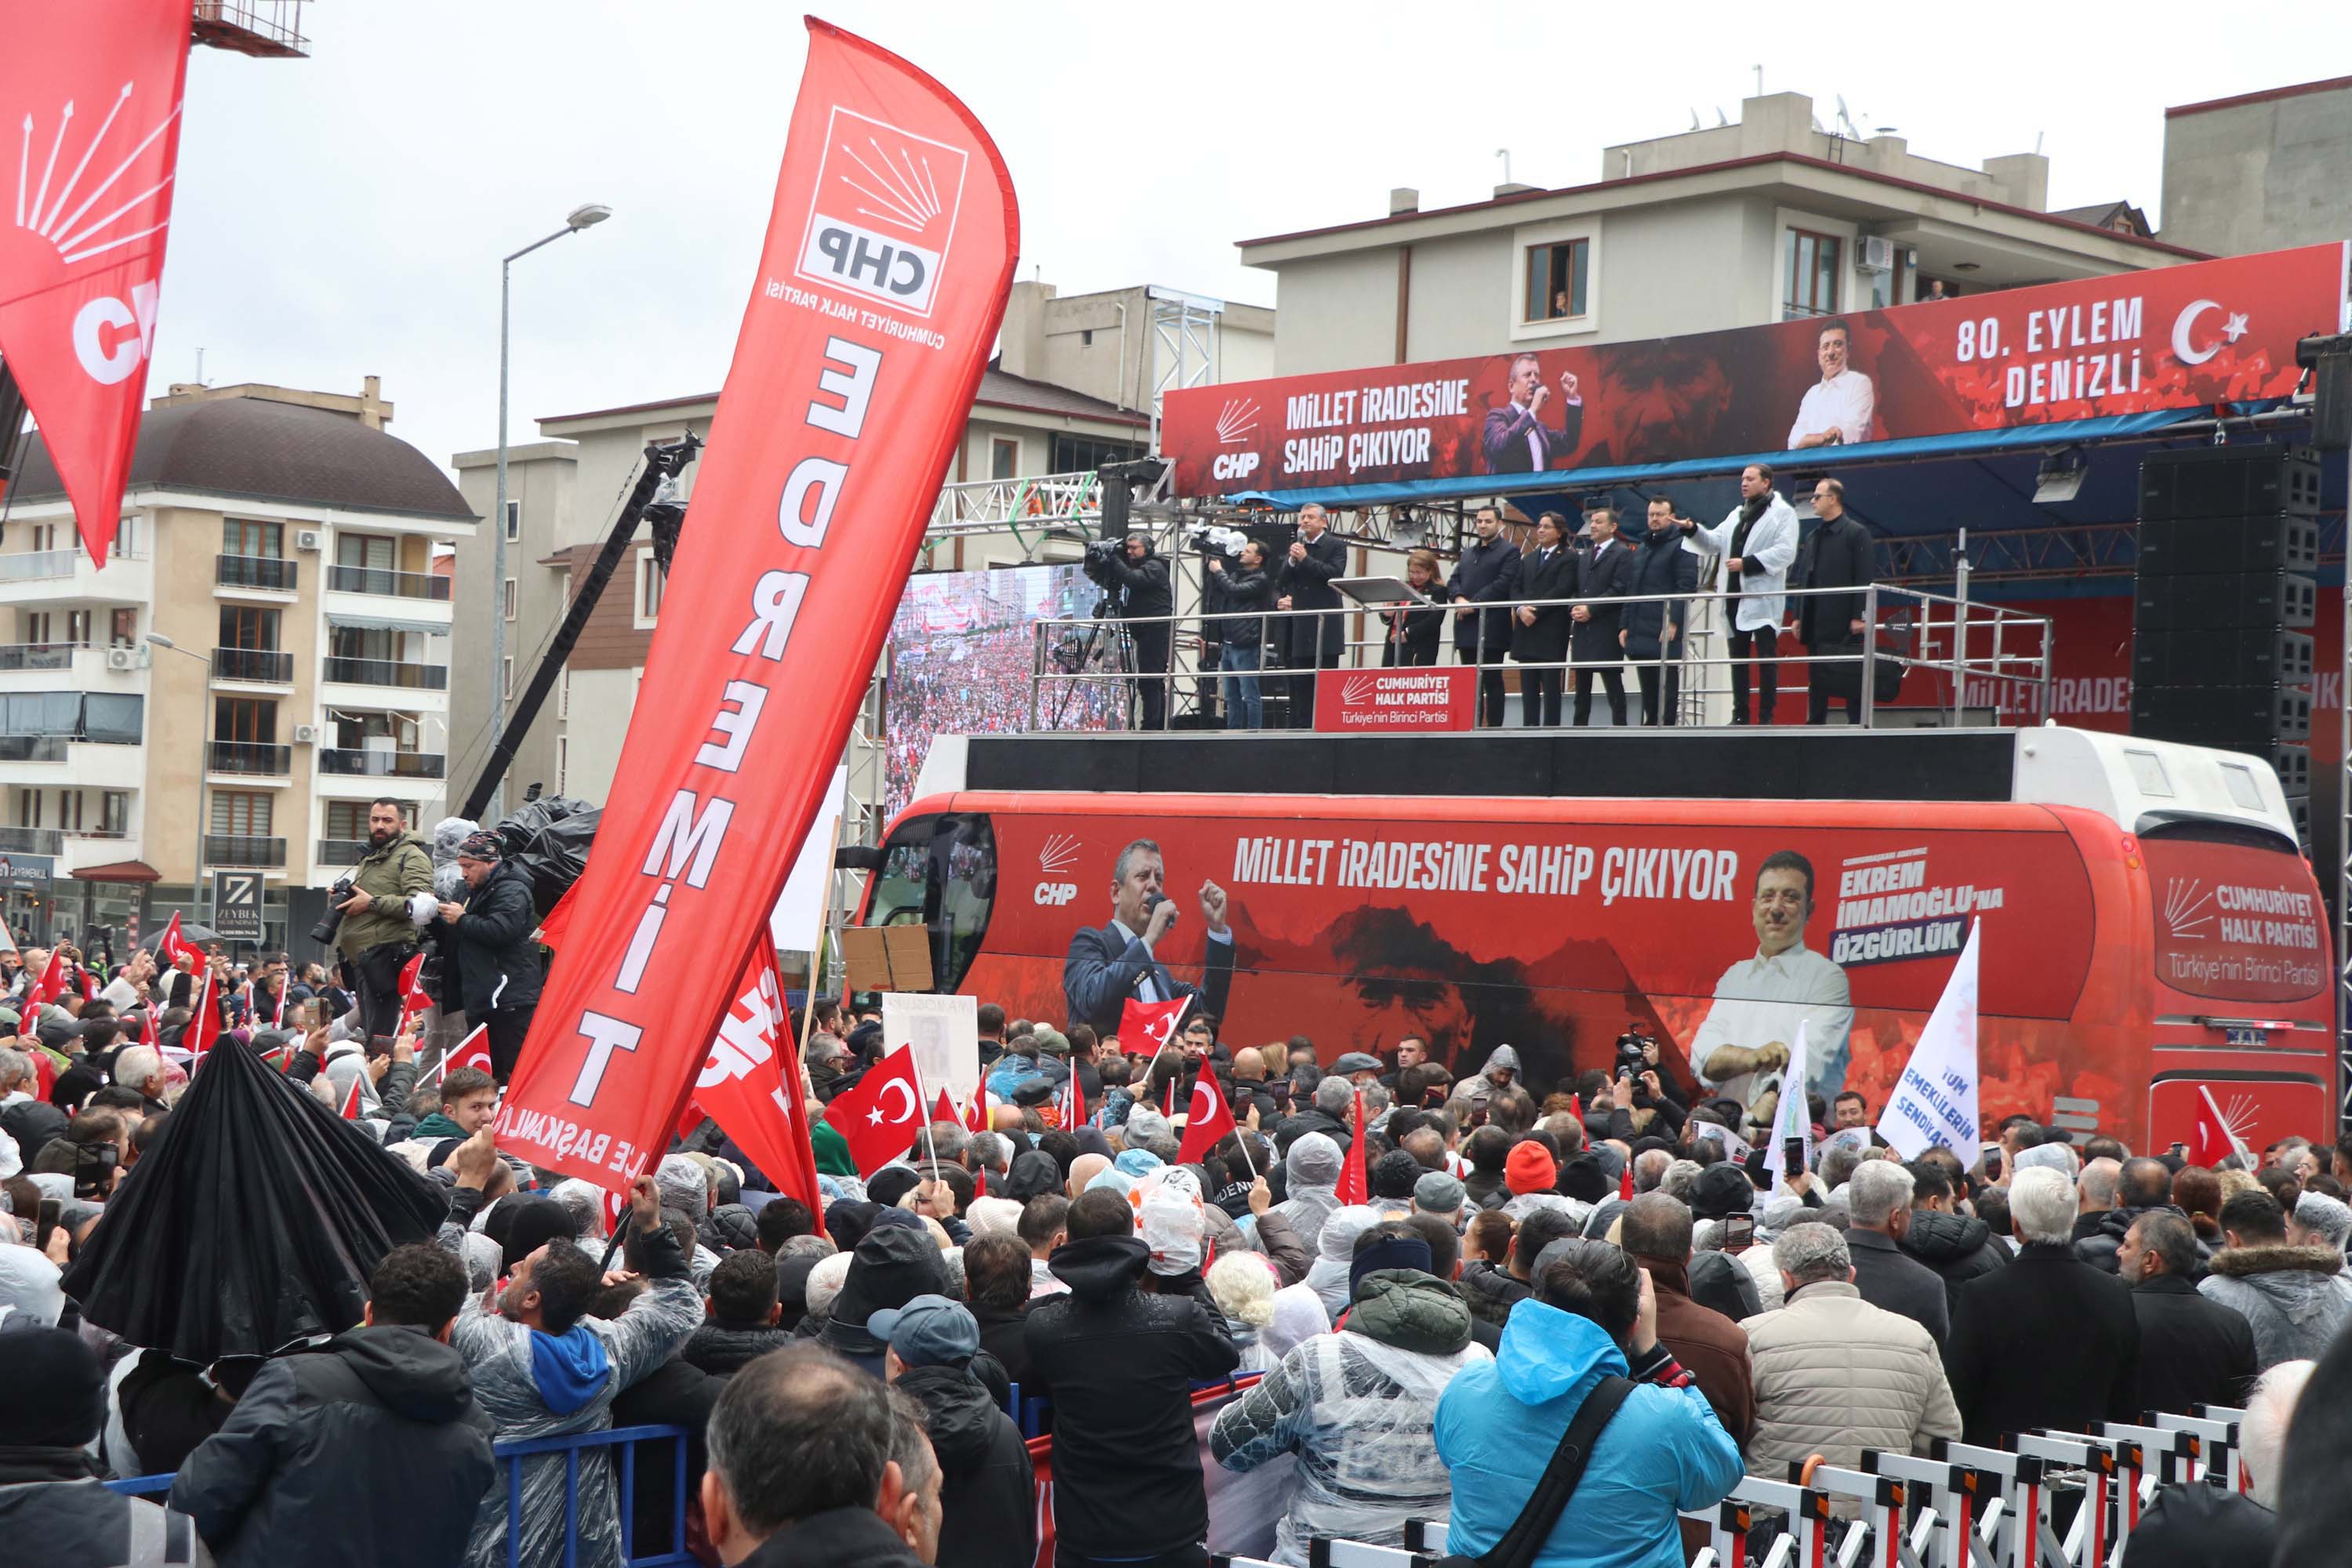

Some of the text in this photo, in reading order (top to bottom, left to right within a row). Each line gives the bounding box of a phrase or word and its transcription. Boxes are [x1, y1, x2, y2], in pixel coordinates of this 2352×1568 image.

[1956, 296, 2143, 362] 80. EYLEM
[2005, 347, 2142, 408] DENİZLİ
[1286, 379, 1470, 431] MİLLET İRADESİNE
[1213, 452, 1261, 481] CHP
[1283, 427, 1432, 476] SAHİP ÇIKIYOR
[1374, 688, 1450, 706] HALK PARTİSİ
[1376, 673, 1450, 690] CUMHURİYET
[2050, 677, 2133, 714] İRADE
[1341, 710, 1449, 726] Türkiye'nin Birinci Partisi
[1232, 837, 1738, 907] MİLLET İRADESİNE SAHİP ÇIKIYOR
[1839, 860, 1926, 898] EKREM
[1033, 881, 1078, 906] CHP
[1835, 884, 2004, 930] İMAMOĞLU'NA
[2216, 884, 2313, 917] CUMHURİYET
[217, 909, 260, 920] ZEYBEK
[2220, 917, 2318, 949] HALK PARTİSİ
[1831, 920, 1962, 964] ÖZGÜRLÜK
[2168, 953, 2319, 985] Türkiye'nin Birinci Partisi
[1896, 1095, 1954, 1150] SENDİKAS
[1903, 1067, 1975, 1142] EMEKLİLERİN
